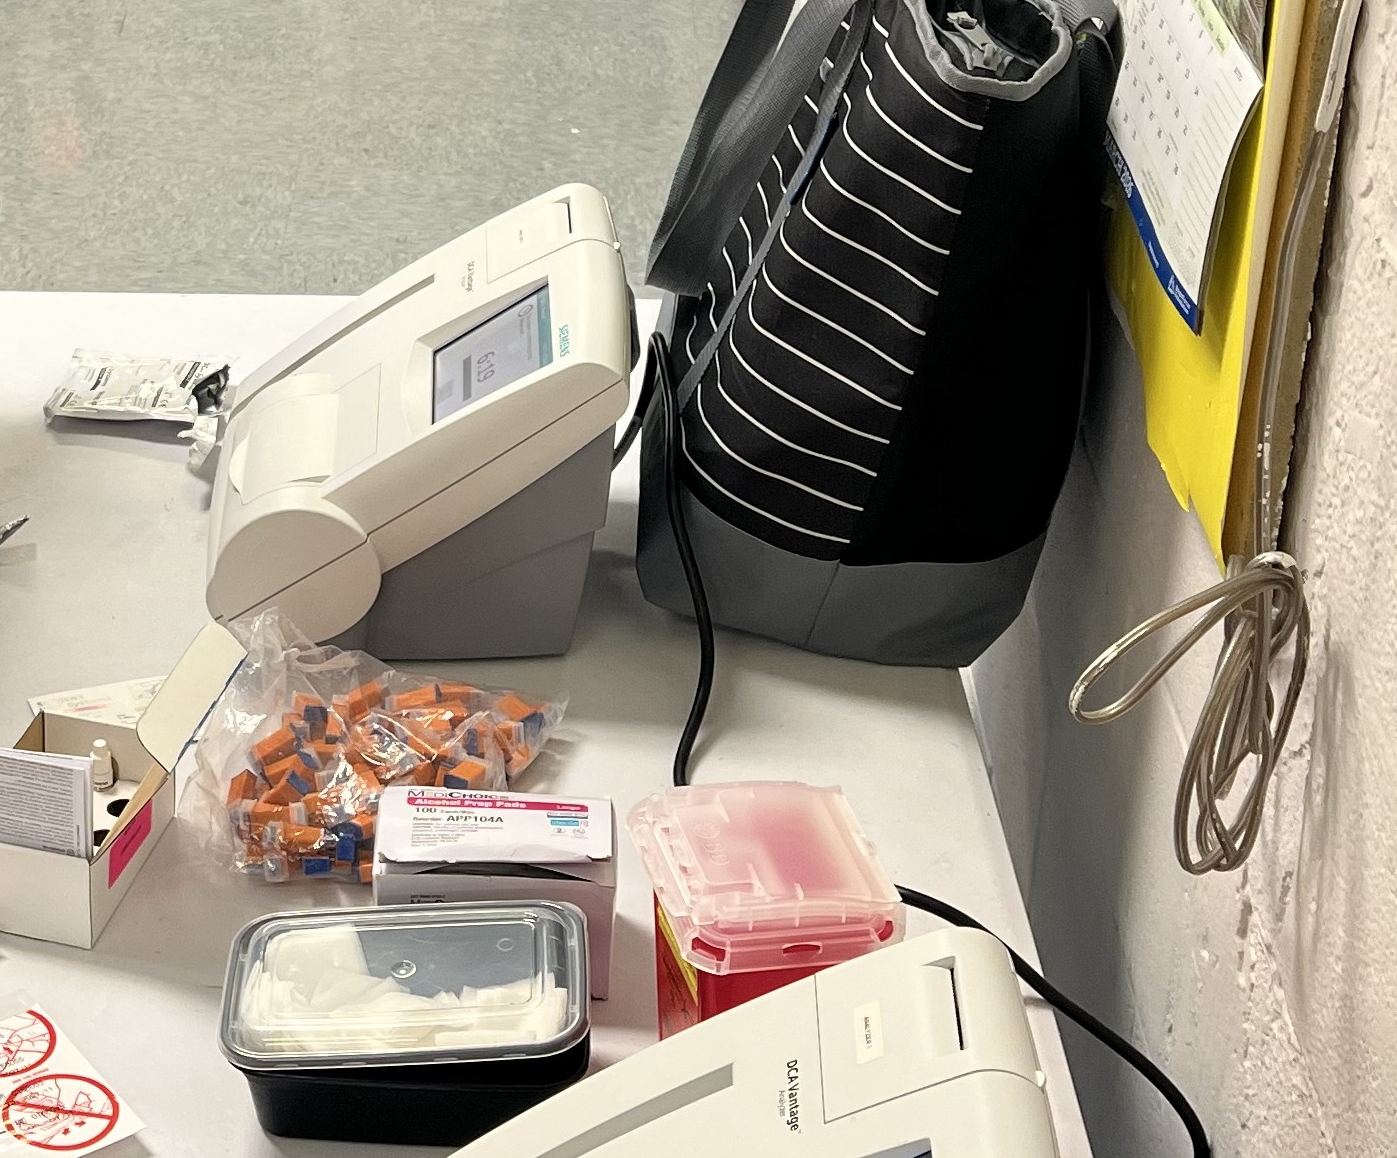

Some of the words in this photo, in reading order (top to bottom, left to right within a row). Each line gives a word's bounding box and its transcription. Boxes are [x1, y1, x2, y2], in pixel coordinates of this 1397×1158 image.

[477, 351, 495, 384] 6:19
[415, 798, 462, 807] Alcohol
[464, 800, 494, 809] Prep
[496, 801, 527, 809] Pads
[446, 814, 505, 824] APP104A
[786, 1058, 799, 1084] DCA
[786, 1082, 800, 1132] Vantage
